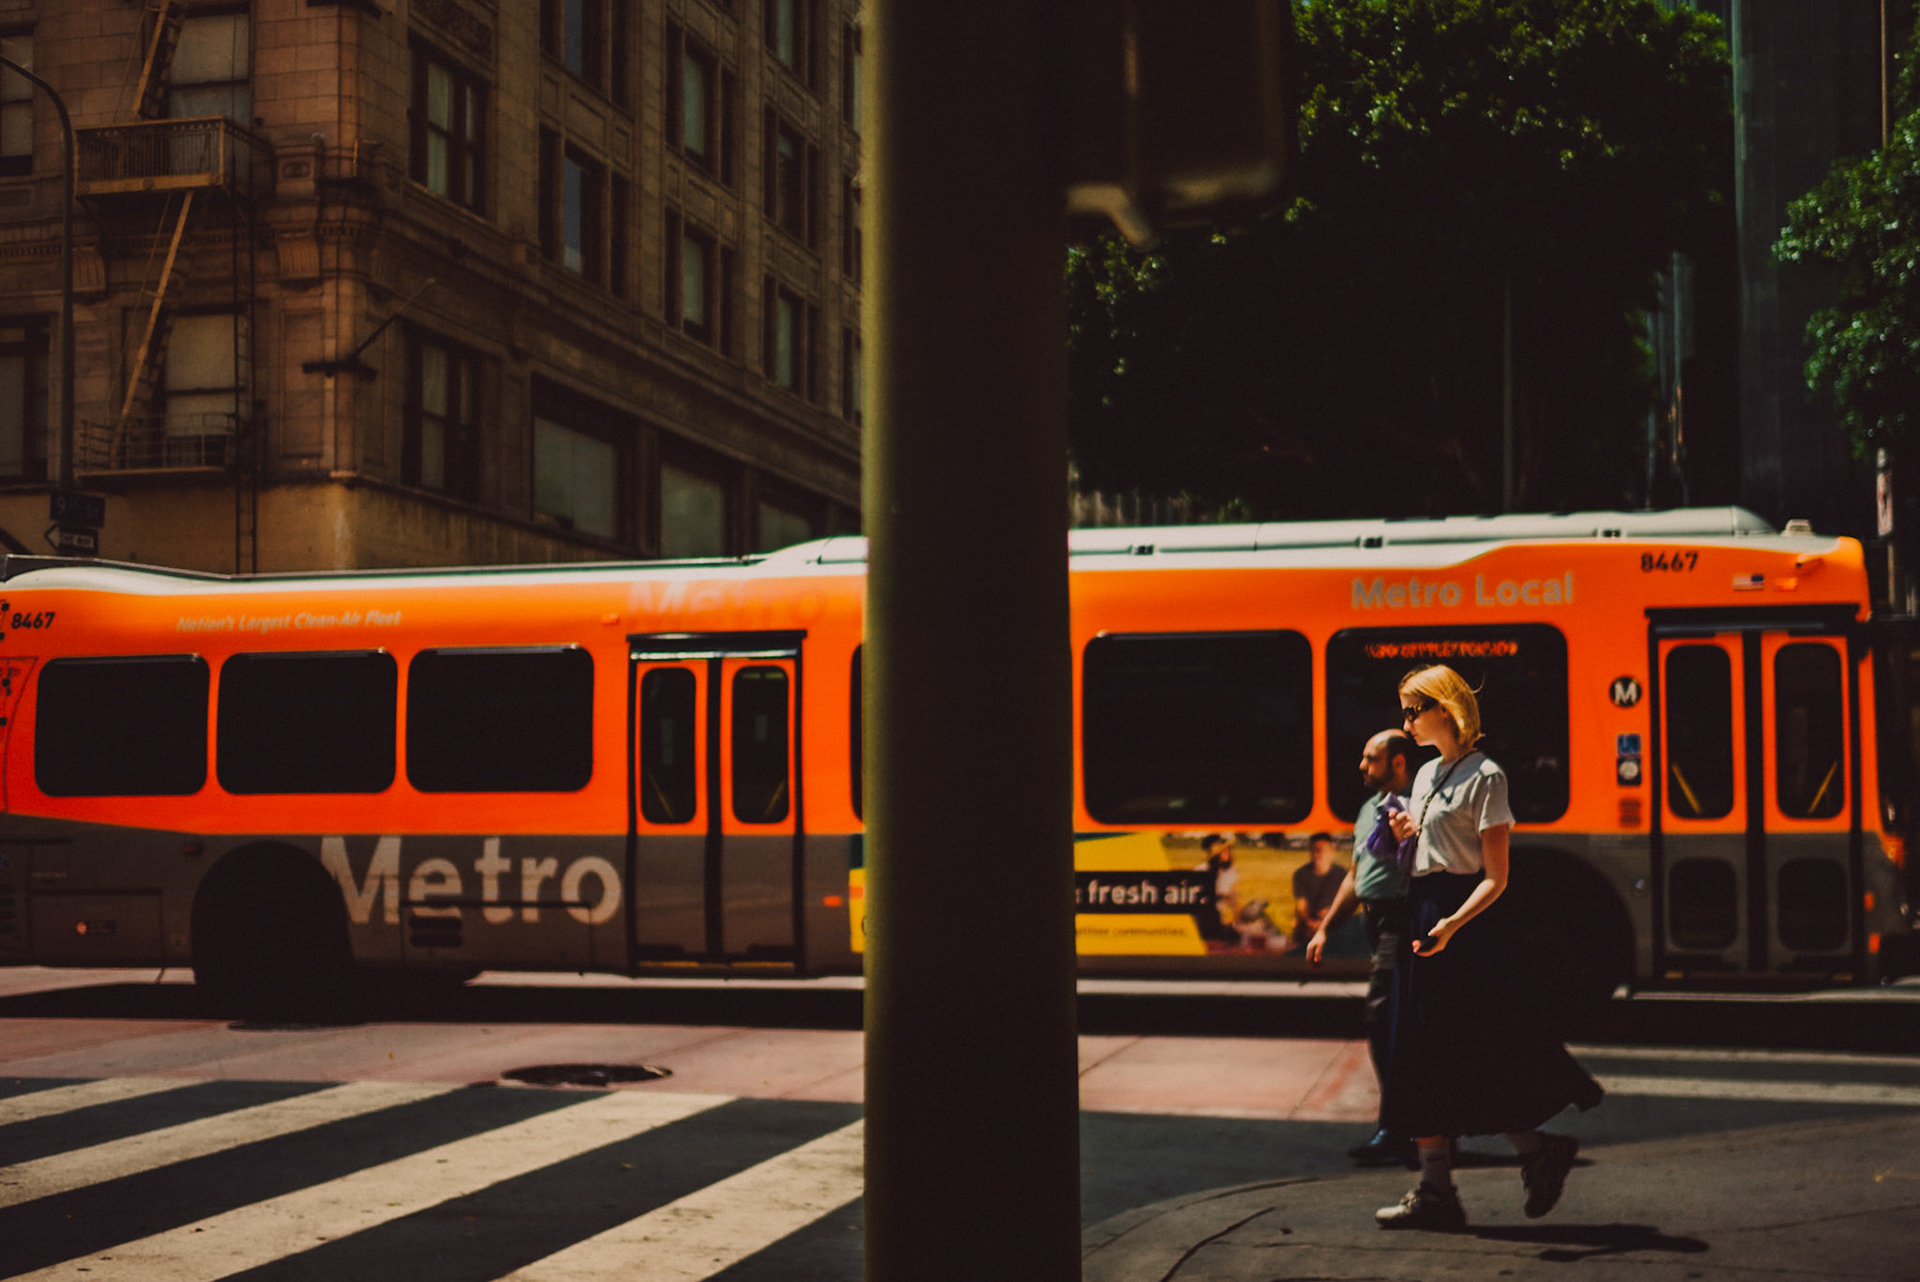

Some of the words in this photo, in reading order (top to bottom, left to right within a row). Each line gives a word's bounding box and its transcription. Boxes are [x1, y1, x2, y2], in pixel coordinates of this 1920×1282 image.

[1640, 552, 1699, 573] 8467
[1352, 576, 1462, 609] Metro
[1475, 570, 1573, 605] Local
[11, 611, 56, 630] 8467
[176, 616, 235, 632] Nation's
[238, 614, 291, 635] Largest
[365, 609, 402, 626] Fleet
[1614, 680, 1638, 706] M
[320, 836, 622, 926] Metro
[1088, 879, 1159, 905] fresh
[1164, 880, 1208, 905] air.
